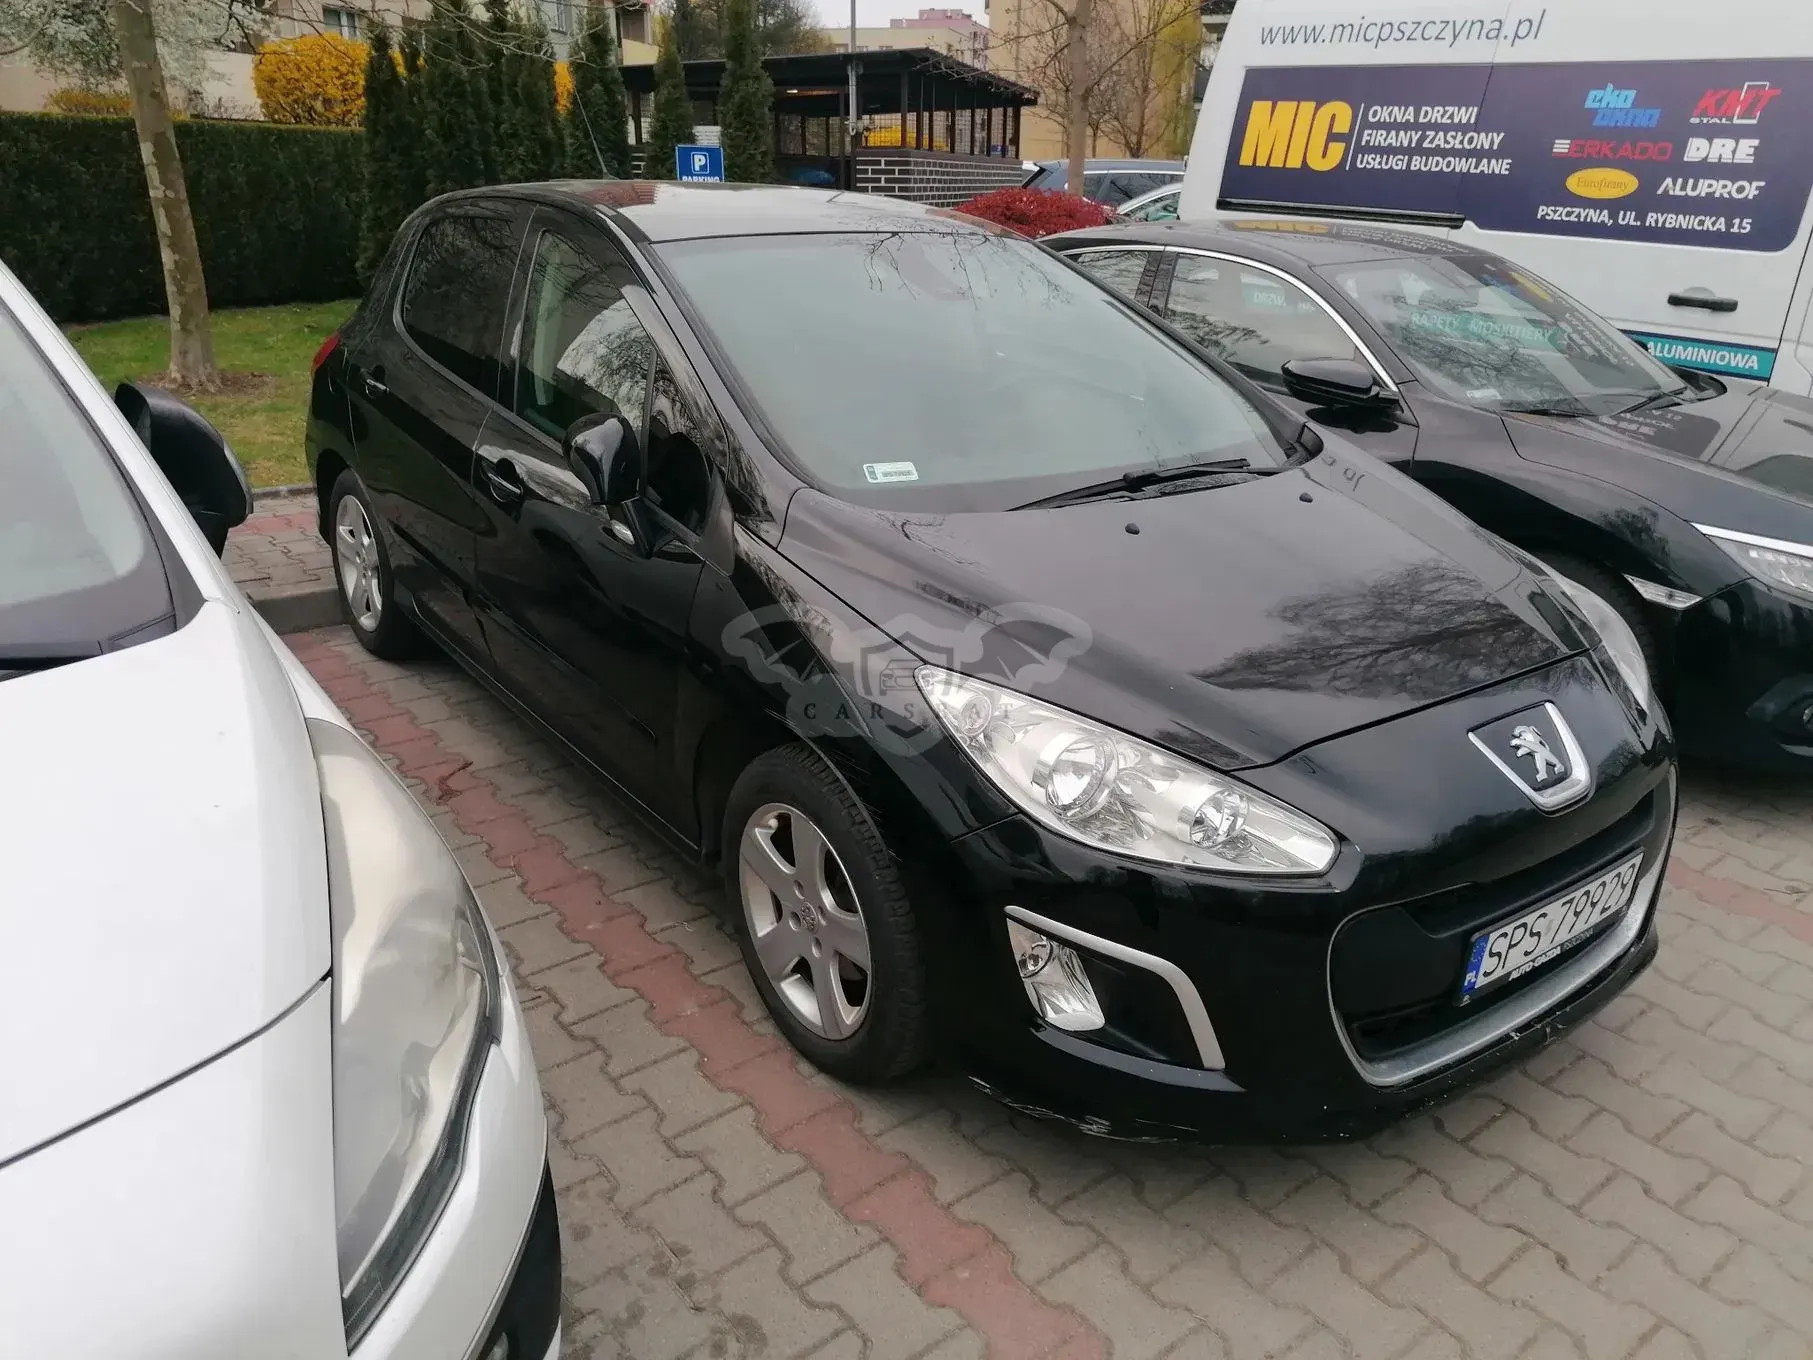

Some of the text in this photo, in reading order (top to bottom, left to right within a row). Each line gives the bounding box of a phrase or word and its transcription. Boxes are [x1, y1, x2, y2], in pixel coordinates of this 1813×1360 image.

[1260, 9, 1546, 48] www.micpszczyna.pl
[1368, 105, 1478, 125] OKNA DRZWI
[1239, 100, 1353, 171] MIC
[1361, 129, 1504, 150] FIRANY ZASŁONY
[1552, 139, 1674, 161] ERKADO
[1683, 137, 1760, 164] DRE
[1356, 153, 1512, 175] USŁUGI BUDOWLANE
[1656, 177, 1766, 200] ALUPROF
[1537, 205, 1753, 234] PSZCZYNA, UL. RYBNICKA 15
[1647, 341, 1759, 370] ALUMINIOWA
[1464, 863, 1636, 987] PL SPS 79929
